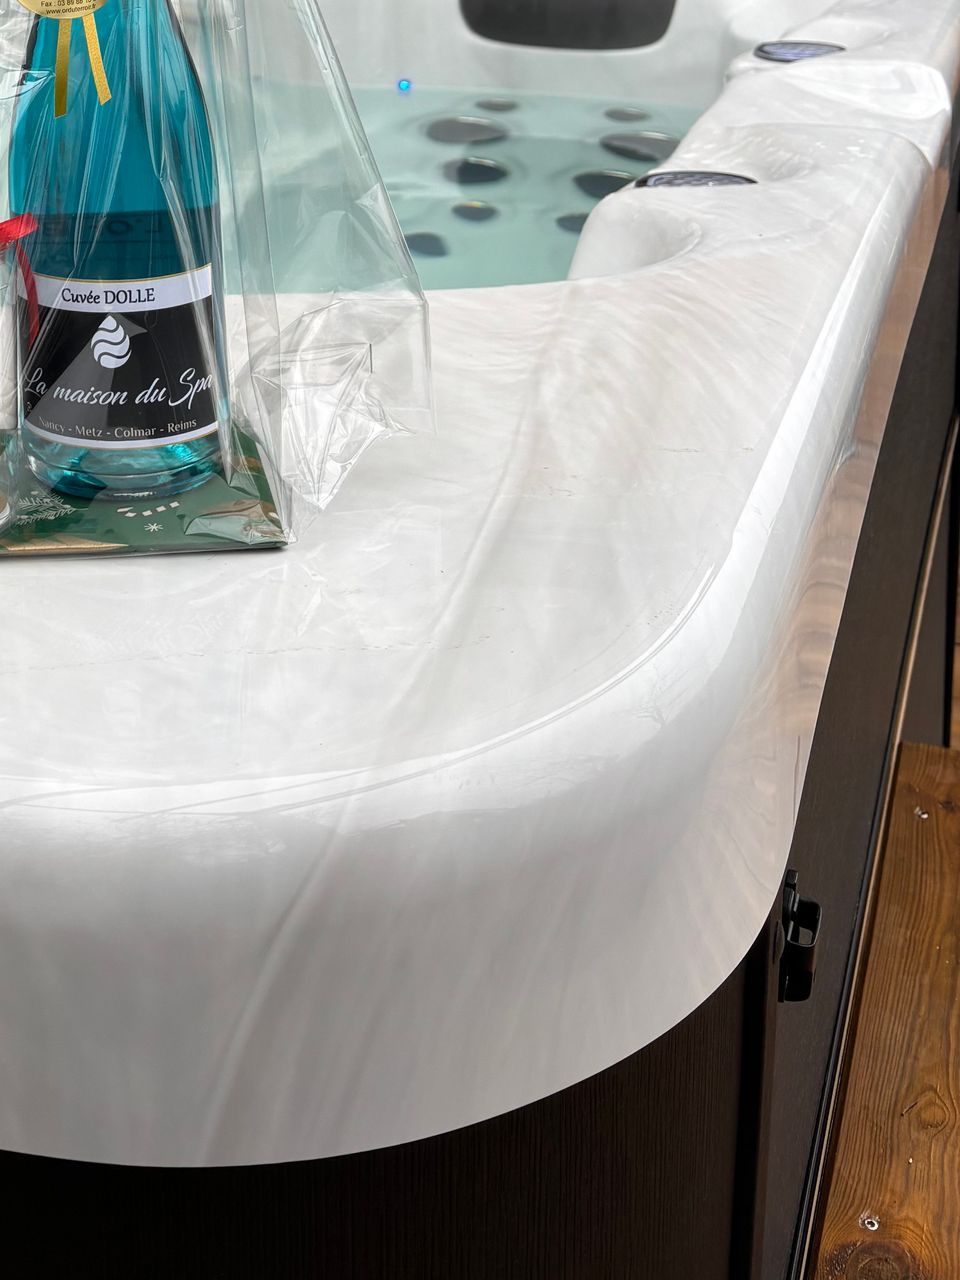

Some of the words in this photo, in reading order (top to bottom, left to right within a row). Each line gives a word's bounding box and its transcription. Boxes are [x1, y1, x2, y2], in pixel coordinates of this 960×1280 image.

[40, 0, 52, 8] Fax
[57, 0, 65, 7] 03
[61, 287, 101, 304] Cuvée
[103, 287, 156, 305] DOLLE
[24, 367, 48, 397] La
[53, 384, 129, 406] maison
[134, 377, 167, 404] du
[168, 367, 213, 410] Spa
[39, 415, 65, 434] Nancy
[75, 425, 103, 438] Metz
[114, 426, 157, 438] Colmar
[167, 418, 197, 434] Reims
